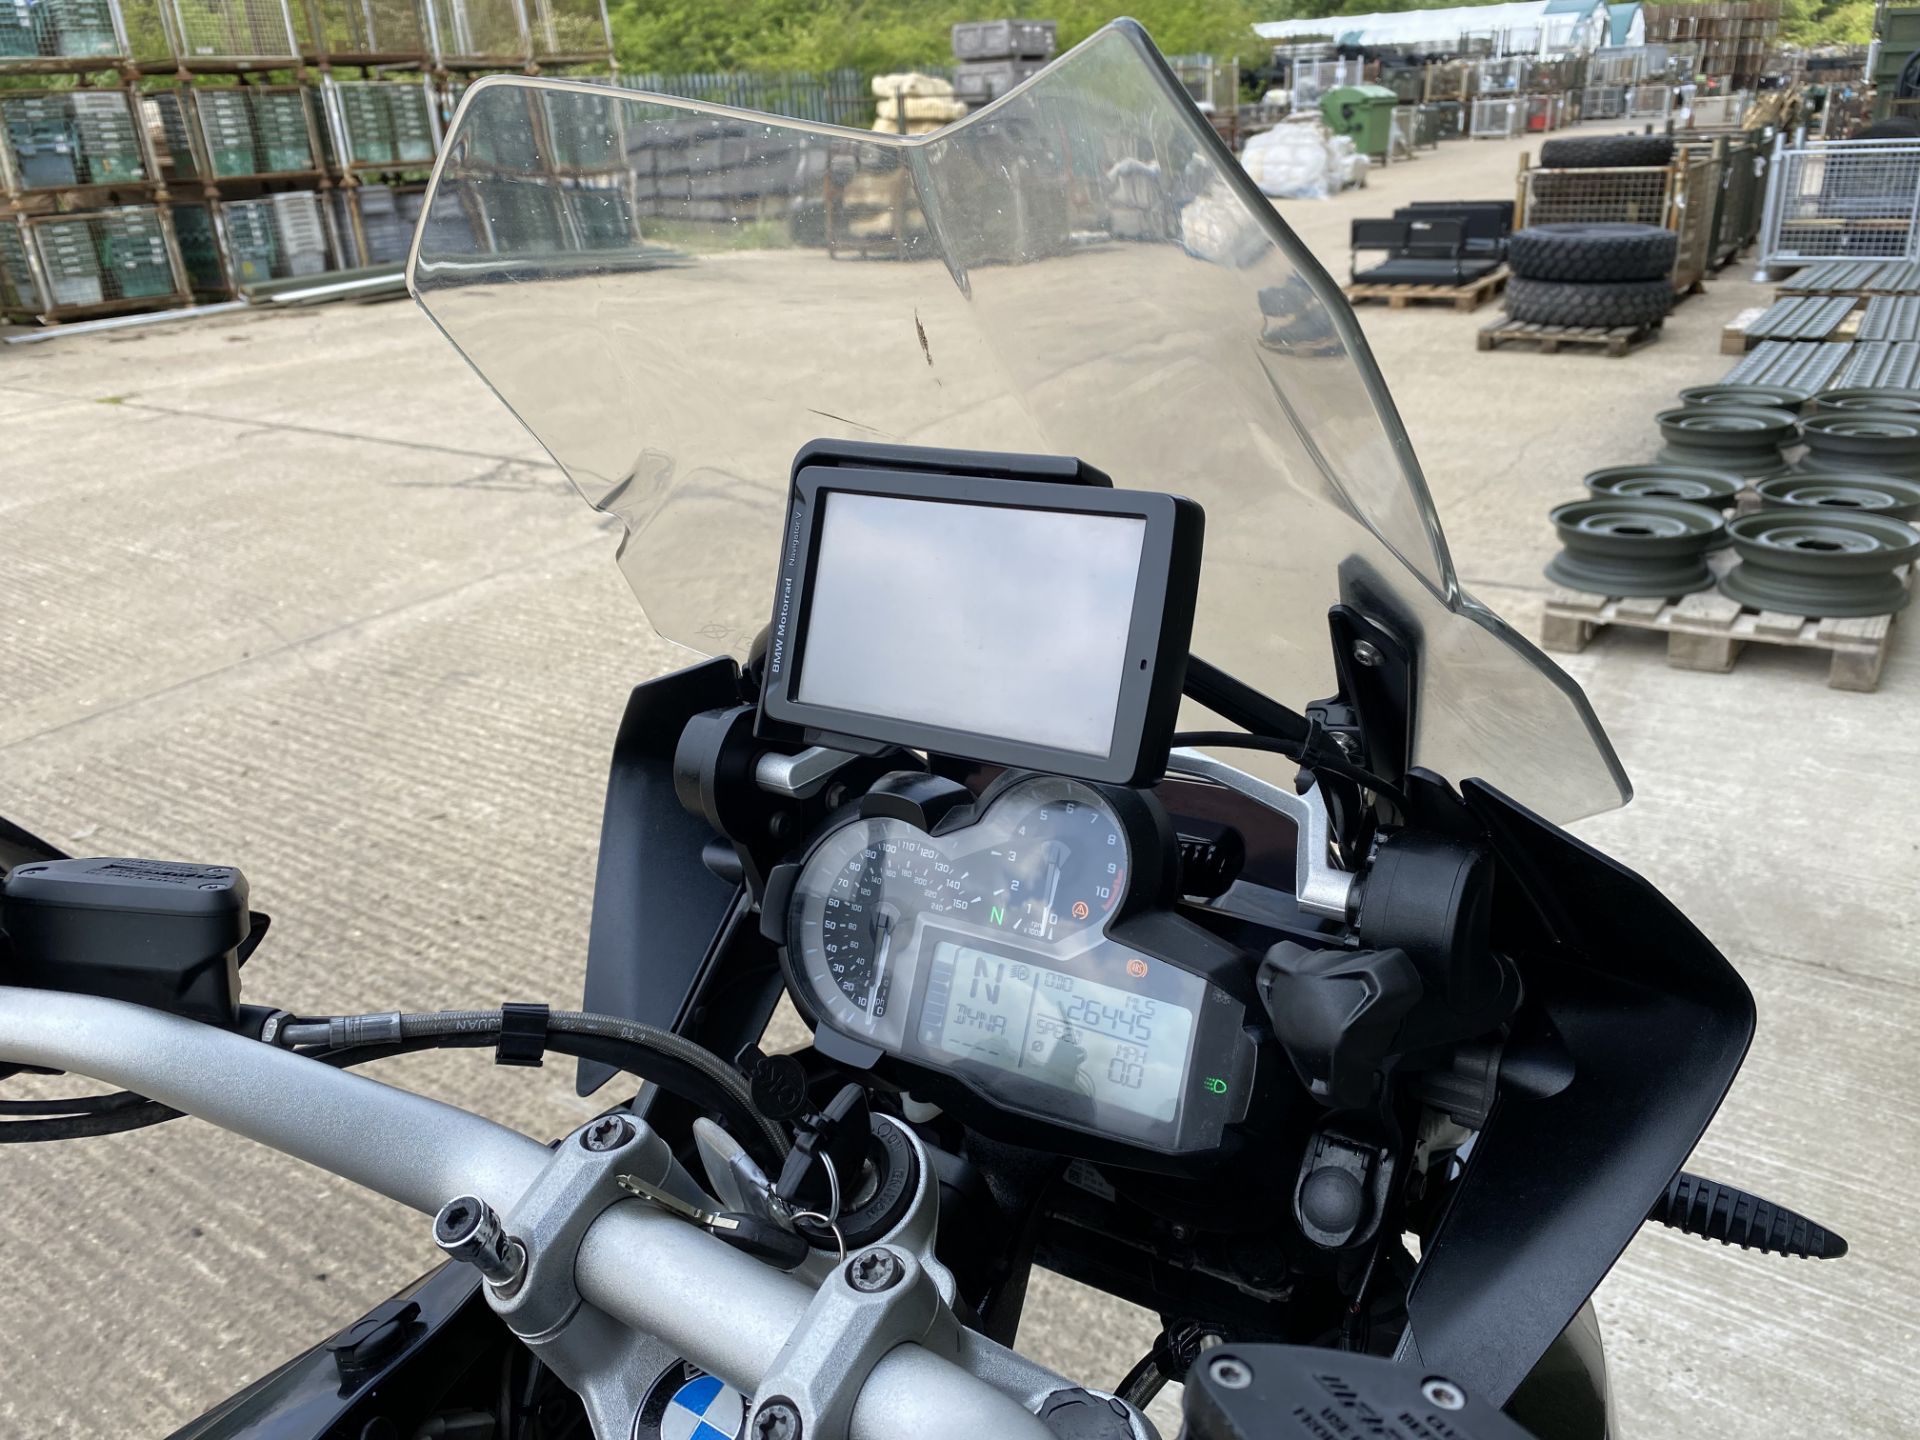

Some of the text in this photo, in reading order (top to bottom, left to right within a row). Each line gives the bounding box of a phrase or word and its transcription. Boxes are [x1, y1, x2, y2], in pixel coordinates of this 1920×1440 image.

[772, 638, 784, 673] BMW
[778, 577, 793, 636] Motorrad
[788, 521, 801, 566] Navigator
[1066, 803, 1075, 814] 6
[1040, 810, 1048, 821] 5
[1091, 813, 1099, 824] 7
[1018, 826, 1026, 836] 4
[1107, 834, 1117, 845] 8
[882, 843, 897, 853] 100
[902, 841, 916, 852] 110
[865, 850, 876, 859] 90
[920, 848, 935, 859] 120
[1008, 851, 1017, 862] 3
[849, 862, 861, 872] 80
[934, 862, 949, 873] 130
[1107, 863, 1116, 874] 9
[838, 878, 849, 888] 70
[946, 878, 961, 890] 140
[1010, 880, 1019, 891] 2
[1095, 886, 1110, 898] 10
[828, 898, 840, 908] 60
[953, 899, 968, 910] 150
[990, 905, 1004, 925] N
[1049, 913, 1058, 925] 0
[825, 920, 836, 930] 50
[826, 943, 838, 953] 40
[833, 963, 845, 973] 30
[842, 981, 855, 991] 20
[970, 957, 1005, 1005] N
[858, 995, 867, 1007] 10
[876, 1006, 883, 1015] 0
[1067, 995, 1152, 1041] 26445
